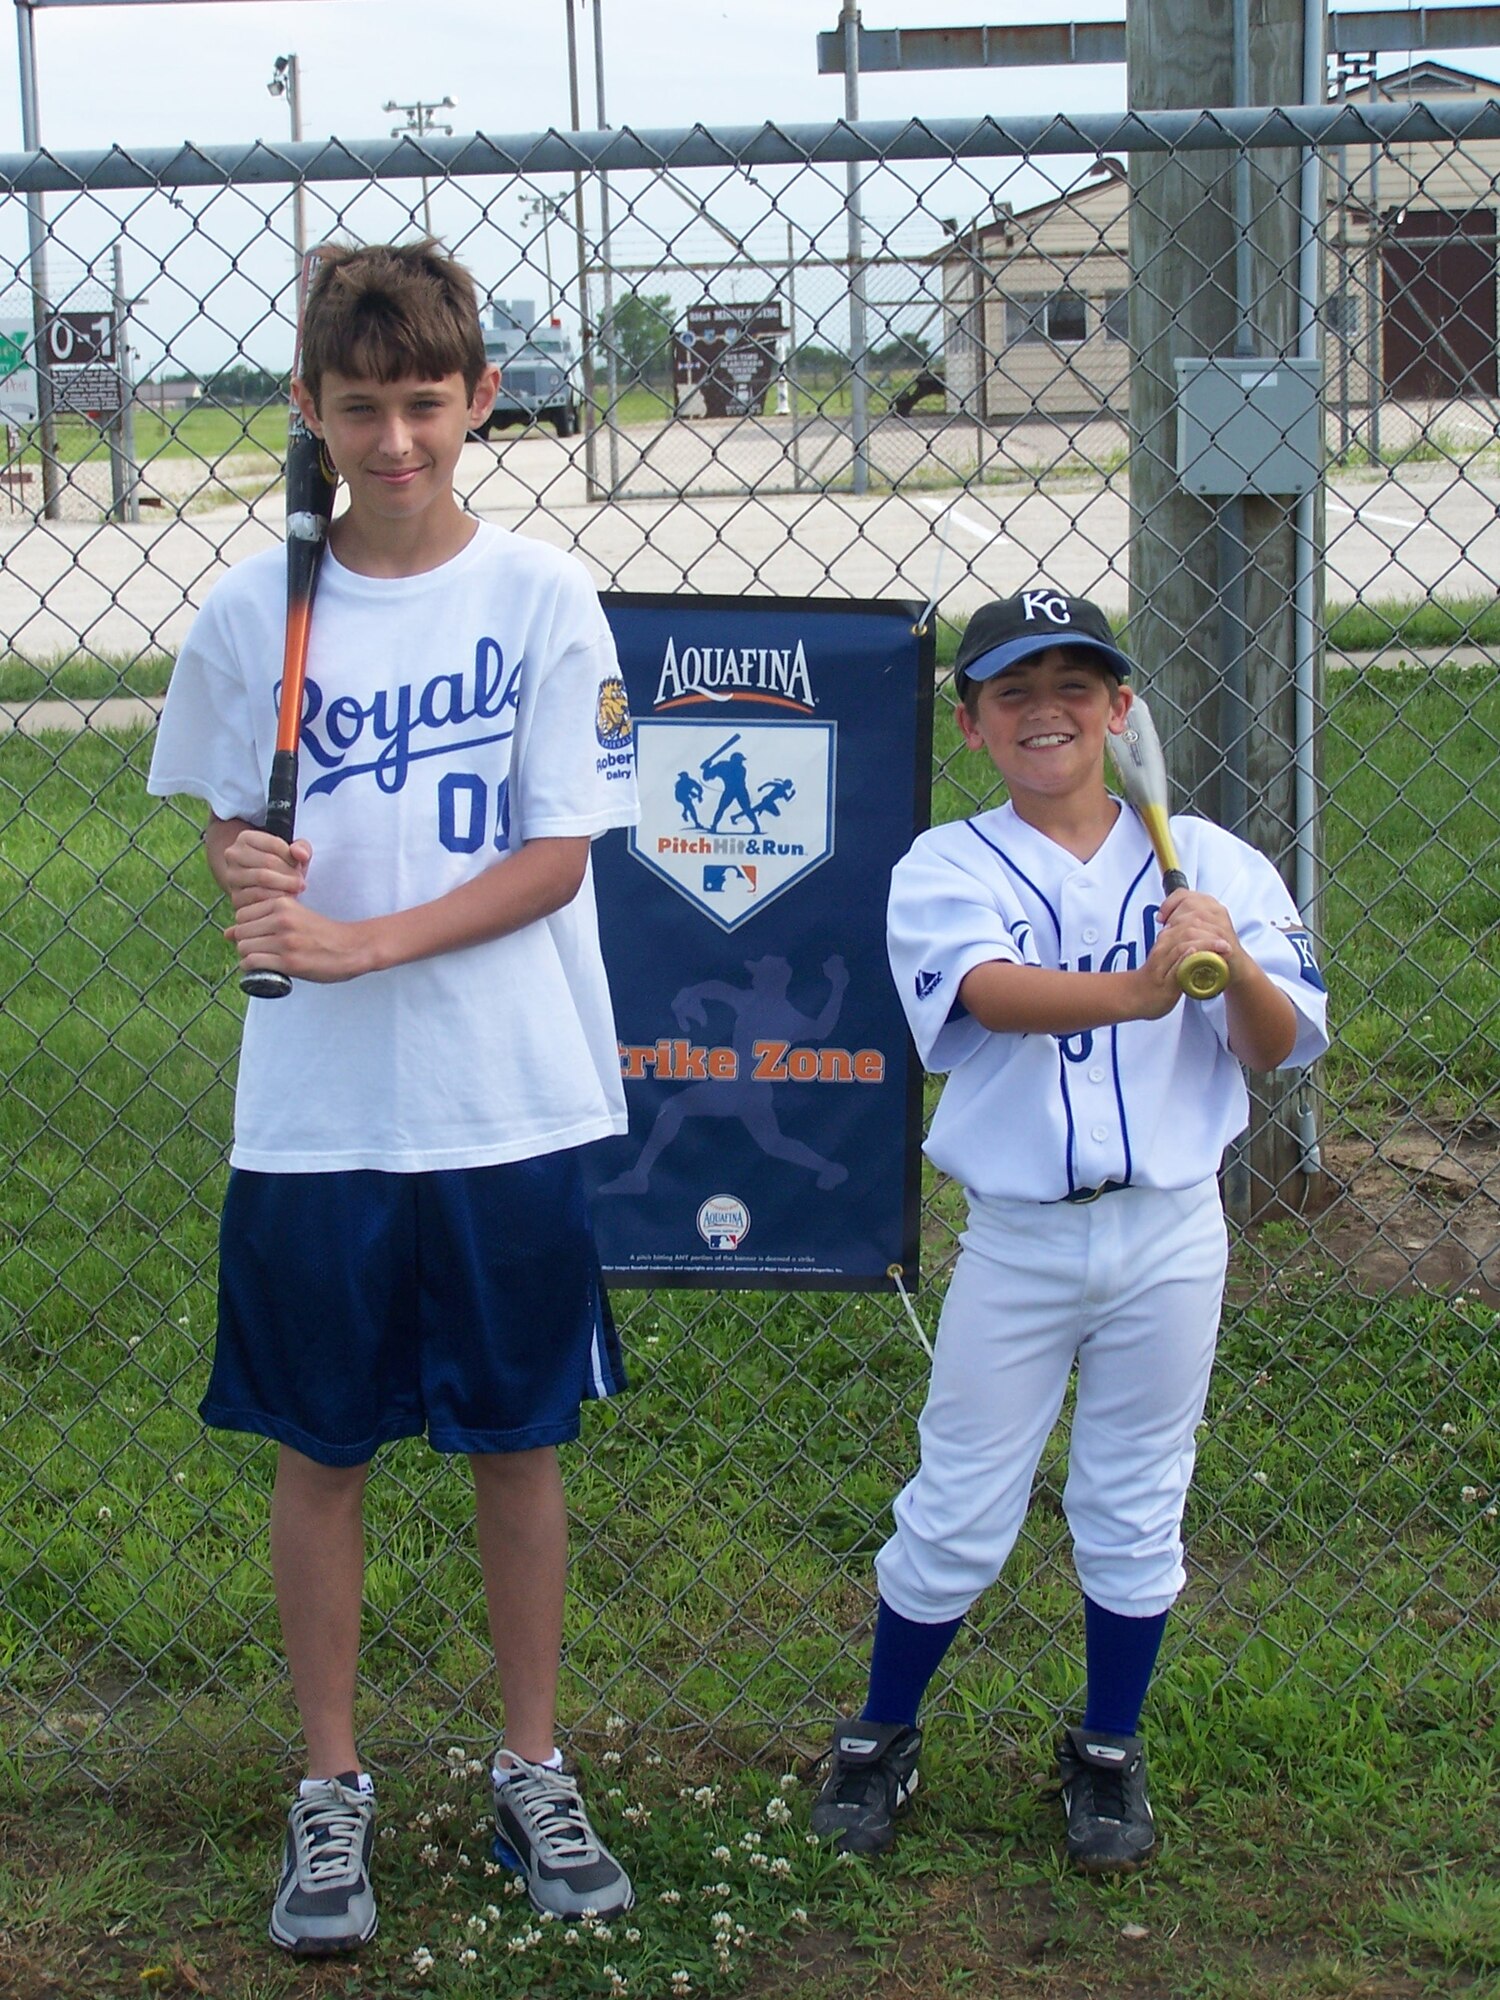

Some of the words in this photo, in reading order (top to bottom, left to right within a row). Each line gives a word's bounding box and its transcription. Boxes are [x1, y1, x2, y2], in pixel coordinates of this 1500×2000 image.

[1022, 590, 1071, 625] KC
[653, 635, 816, 708] AQUAFINA
[606, 768, 632, 780] Dairy
[752, 1039, 885, 1083] Zone
[703, 1210, 744, 1228] AQUAFINA
